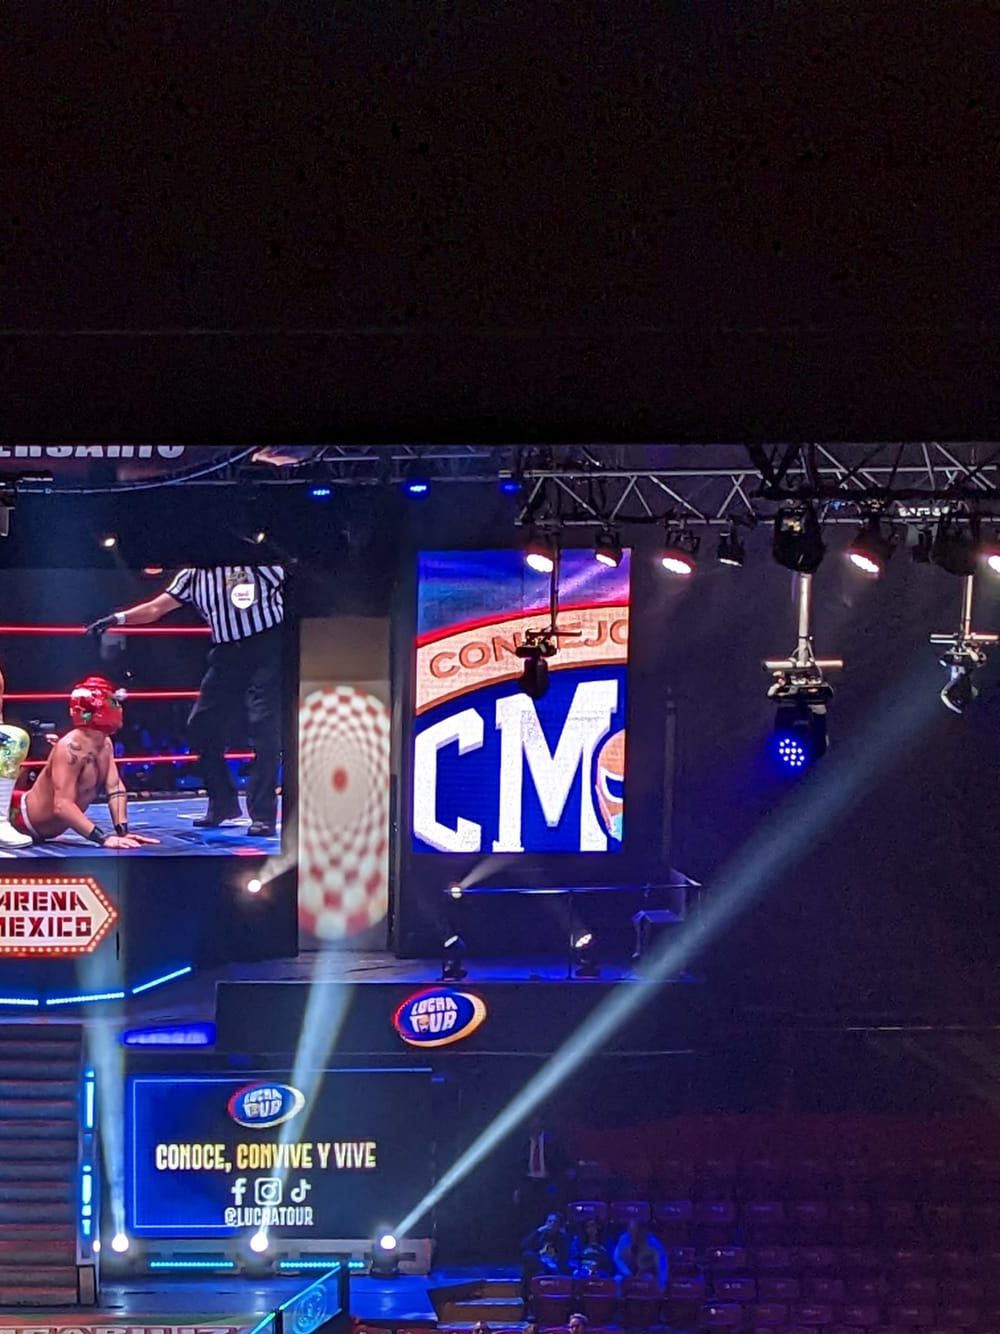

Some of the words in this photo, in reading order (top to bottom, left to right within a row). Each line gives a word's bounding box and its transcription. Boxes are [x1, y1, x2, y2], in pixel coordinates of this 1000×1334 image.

[429, 619, 628, 679] CONEJO
[410, 996, 458, 1016] LUCHA
[155, 1143, 232, 1173] CONOCE,
[235, 1143, 313, 1170] CONVIVE
[317, 1142, 332, 1169] Y
[334, 1142, 377, 1169] VIVE
[223, 1206, 314, 1227] @LUCHATOUR
